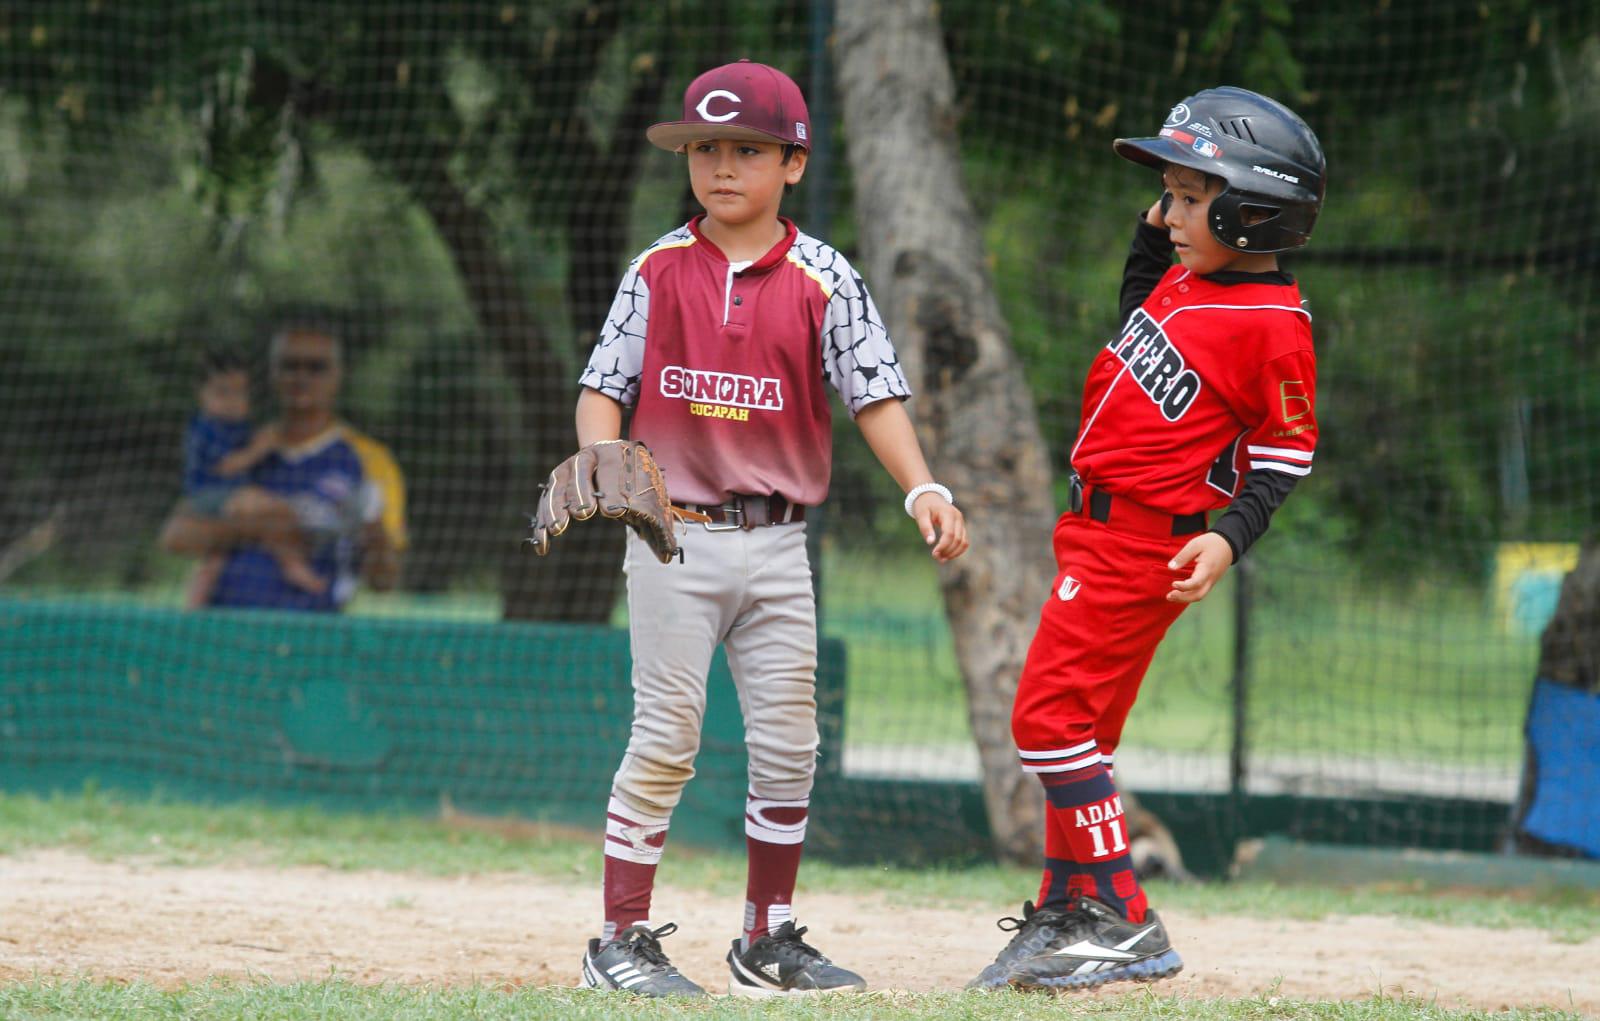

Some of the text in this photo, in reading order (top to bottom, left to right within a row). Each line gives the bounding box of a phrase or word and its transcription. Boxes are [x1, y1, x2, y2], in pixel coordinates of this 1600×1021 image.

[695, 89, 742, 122] C
[660, 365, 783, 410] SONORA
[690, 402, 750, 421] CUCAPAH
[1087, 819, 1127, 858] 11
